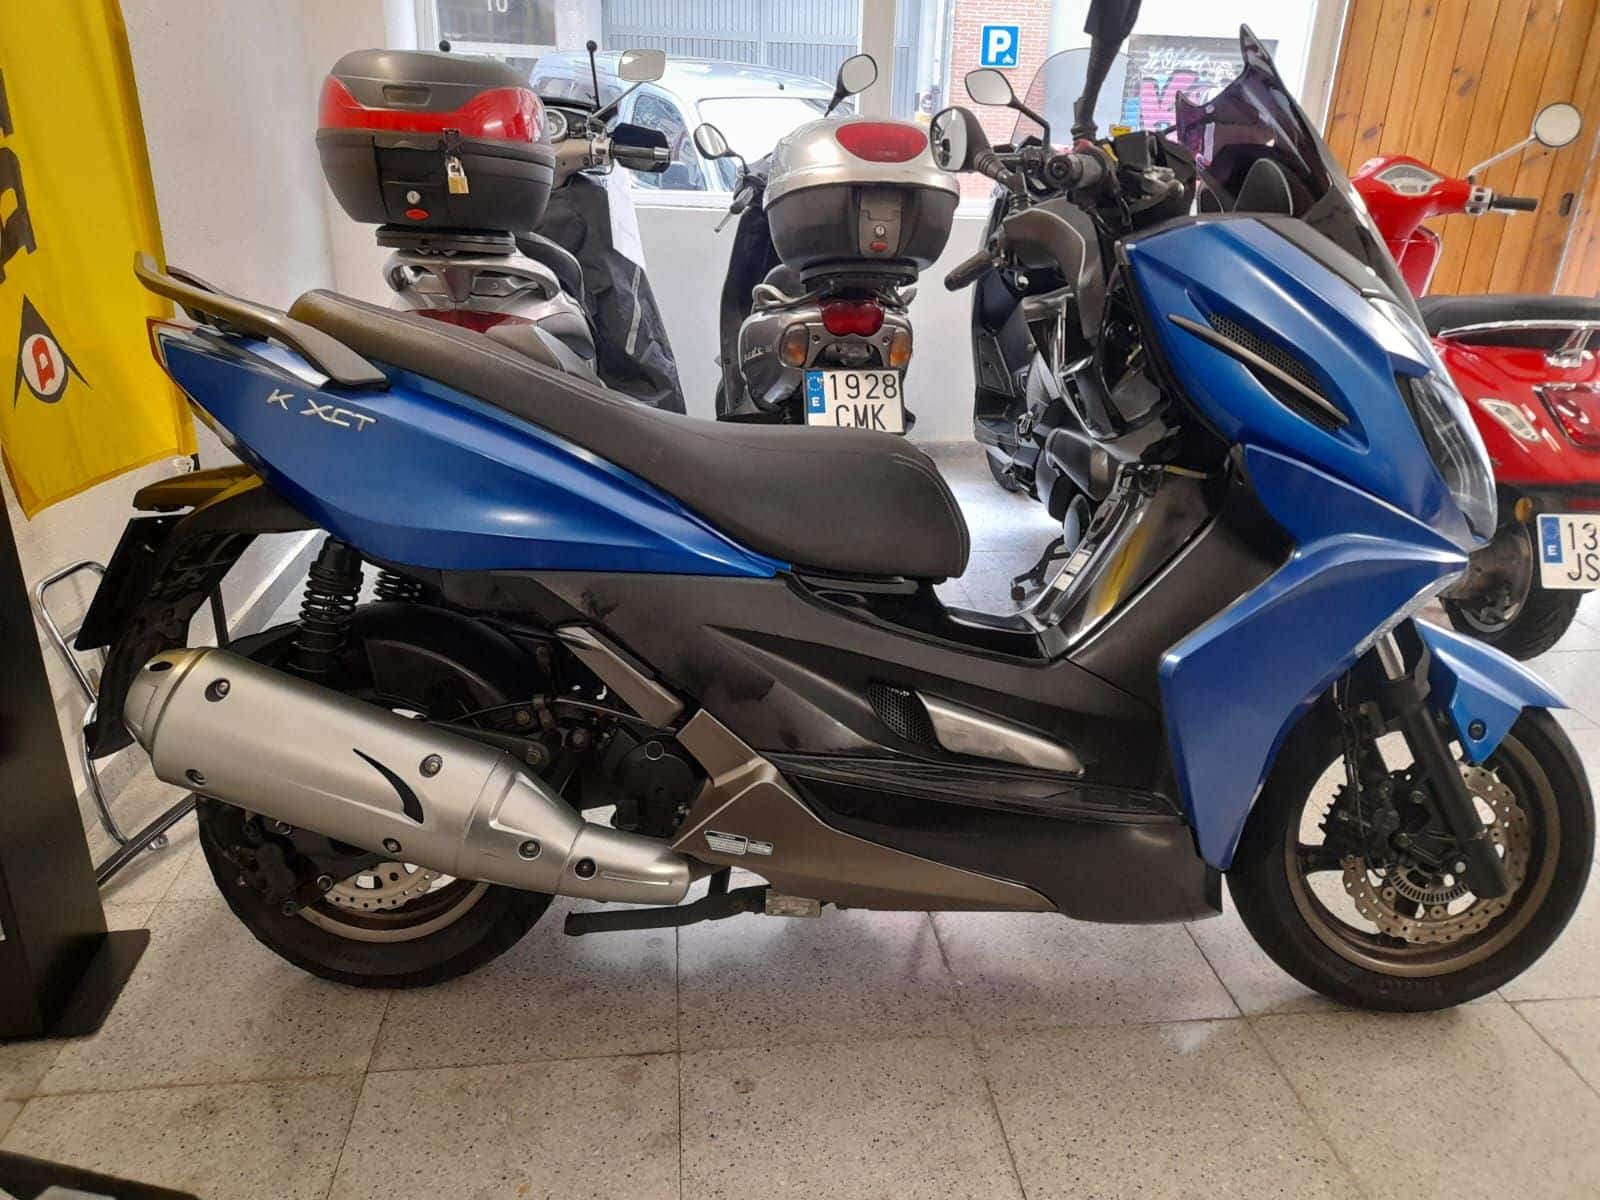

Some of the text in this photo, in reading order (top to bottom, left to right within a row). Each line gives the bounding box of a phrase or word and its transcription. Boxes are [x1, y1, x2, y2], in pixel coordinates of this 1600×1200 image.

[988, 29, 1012, 63] P
[830, 373, 897, 400] 1928
[267, 389, 377, 432] K XCT
[812, 396, 821, 407] E
[835, 403, 886, 430] CMK
[1547, 544, 1558, 556] E
[1568, 522, 1598, 551] 13
[1568, 553, 1600, 582] JS
